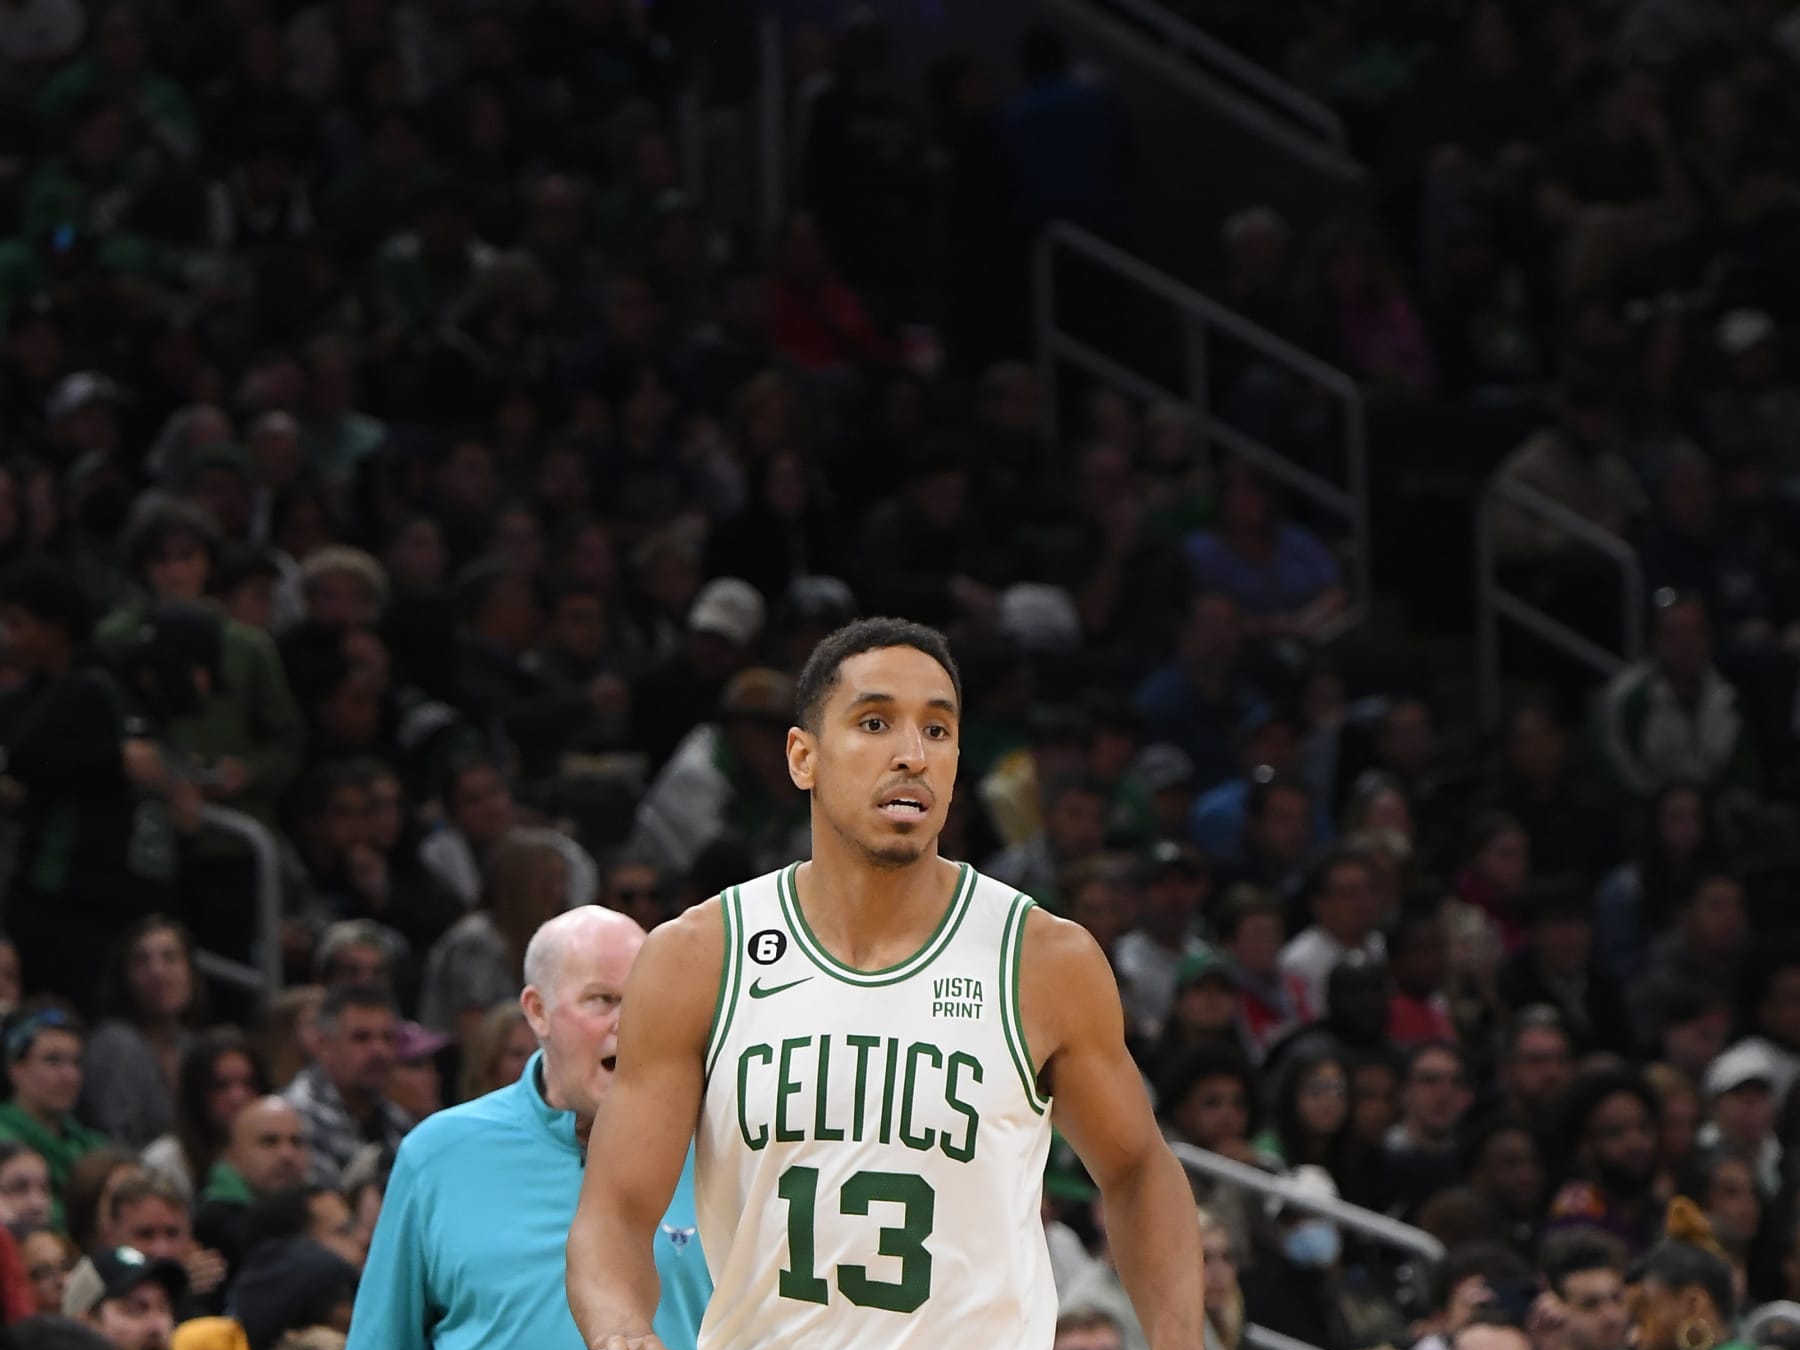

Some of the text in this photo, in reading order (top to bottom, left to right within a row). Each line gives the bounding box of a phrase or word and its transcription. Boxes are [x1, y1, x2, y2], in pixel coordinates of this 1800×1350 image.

[756, 933, 779, 961] 6
[933, 977, 983, 1002] VISTA
[932, 1001, 983, 1019] PRINT
[737, 1034, 984, 1164] CELTICS
[777, 1164, 936, 1314] 13
